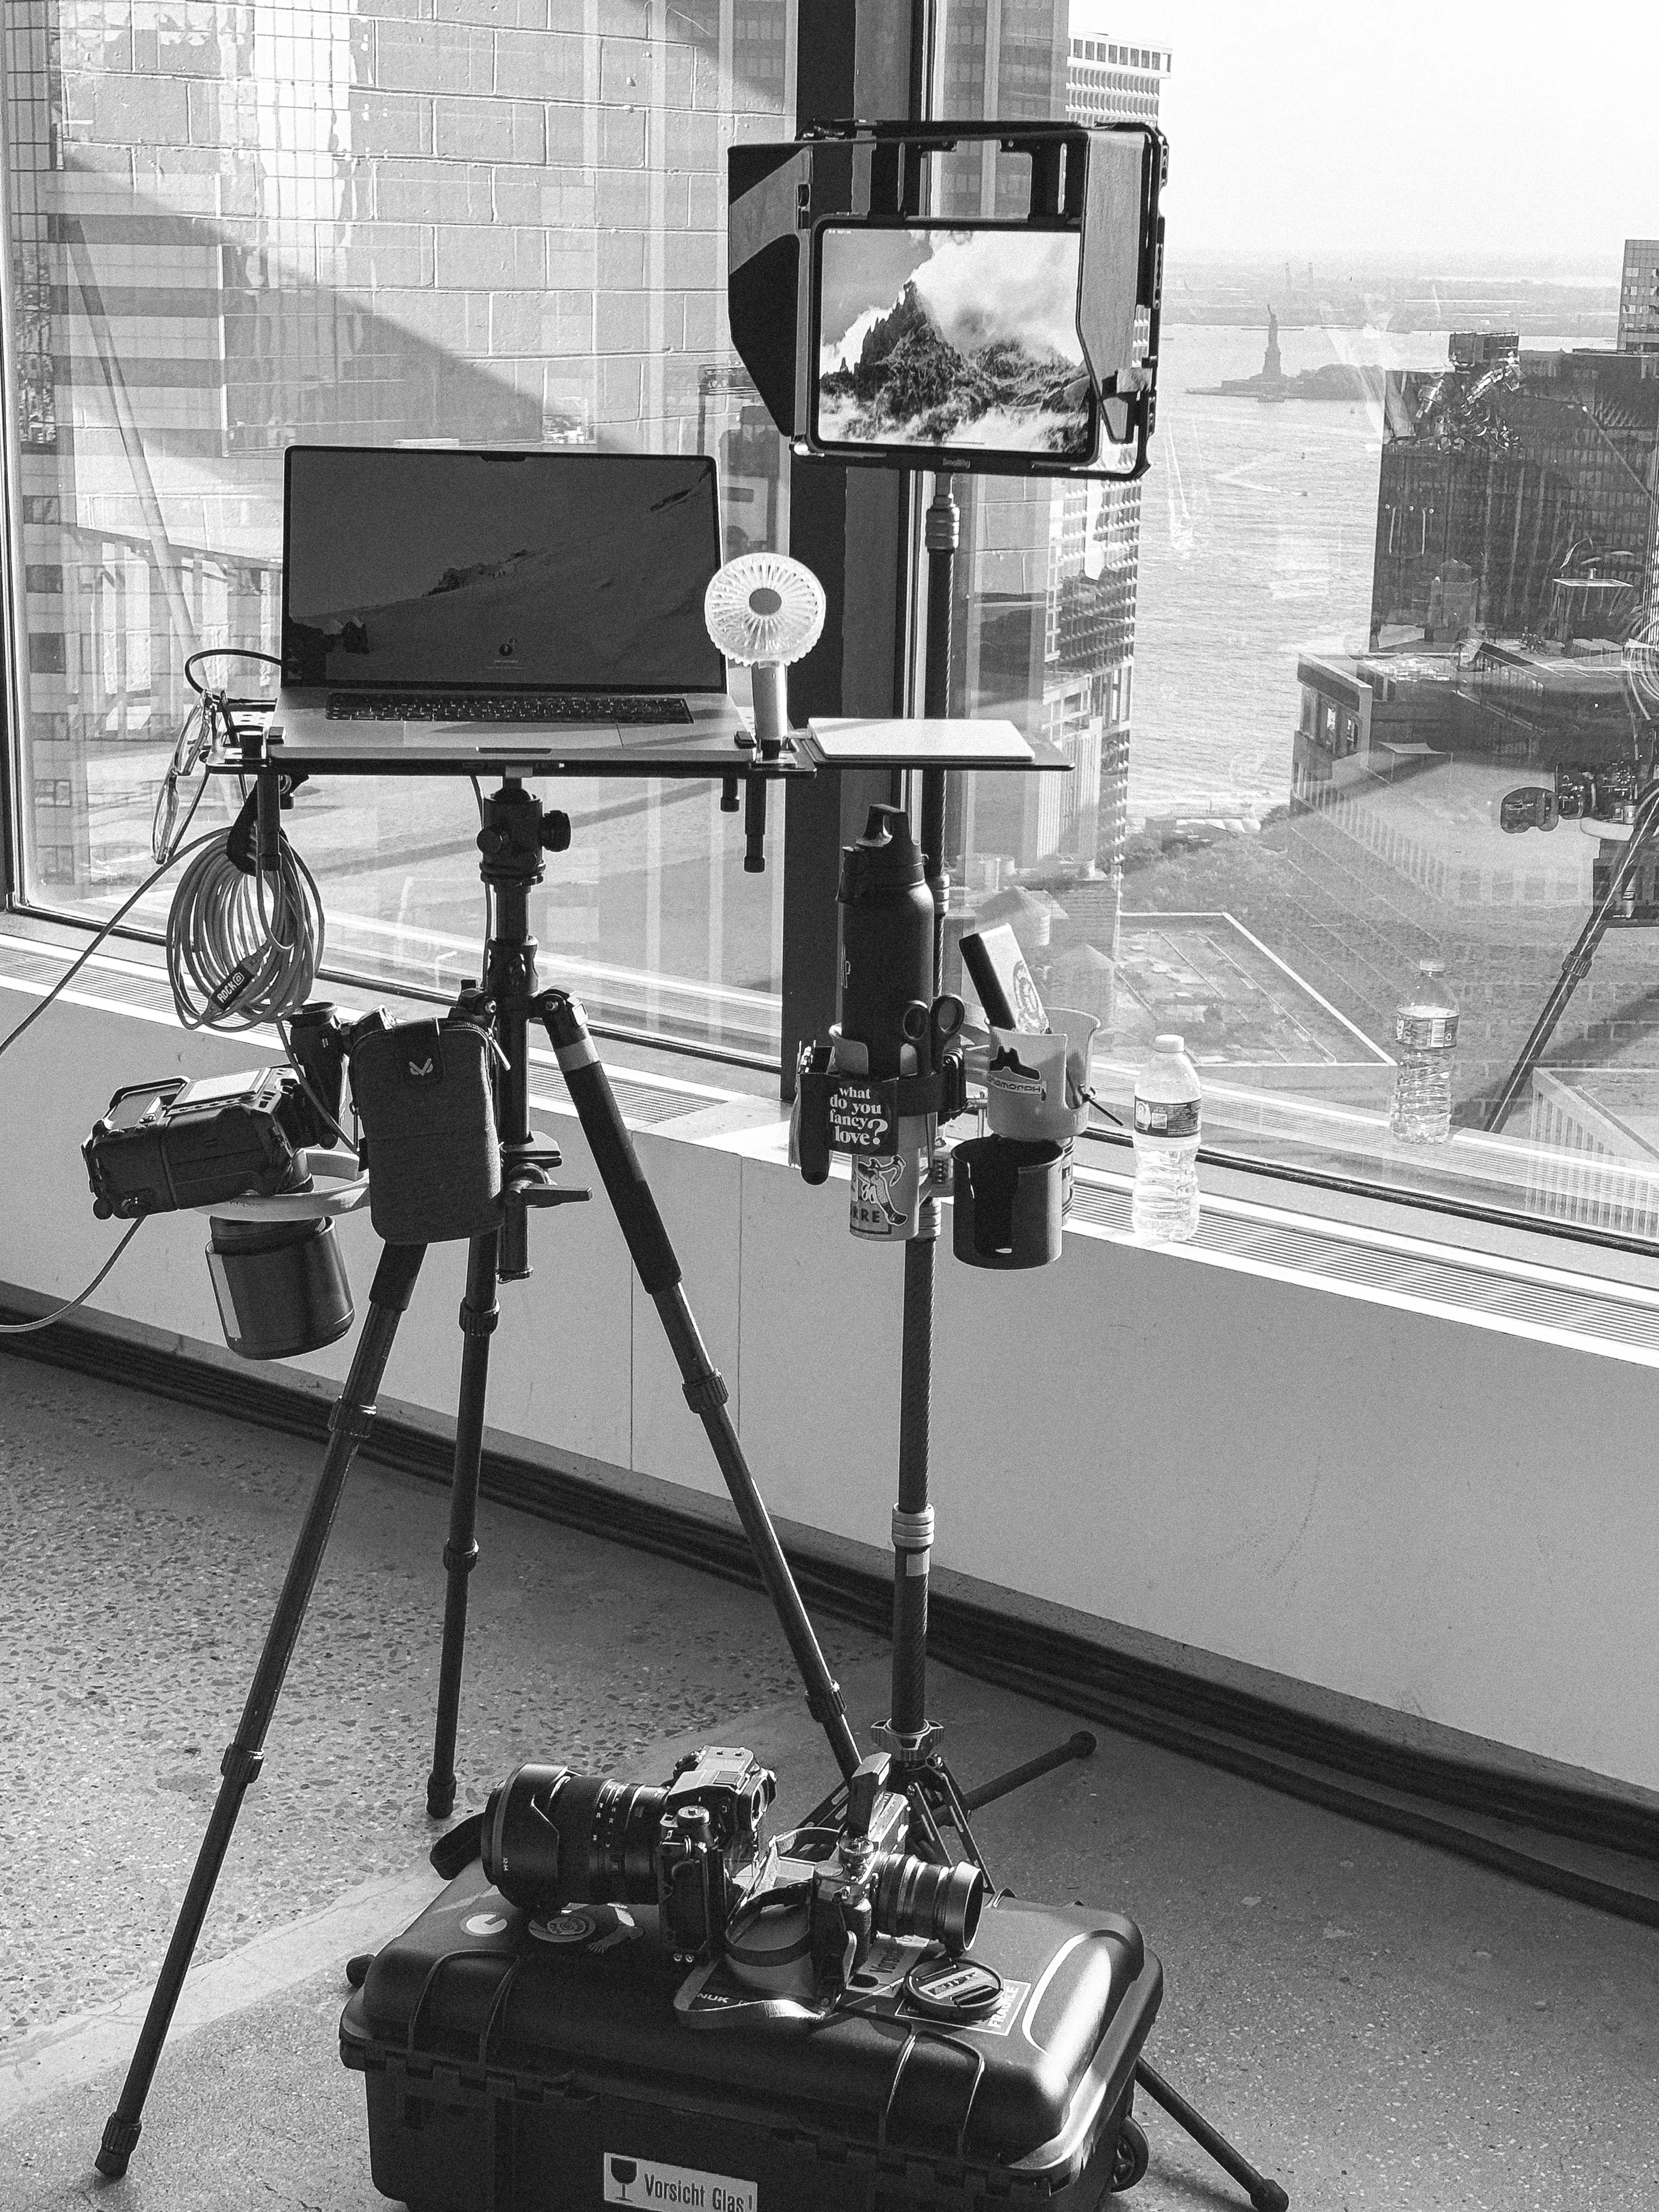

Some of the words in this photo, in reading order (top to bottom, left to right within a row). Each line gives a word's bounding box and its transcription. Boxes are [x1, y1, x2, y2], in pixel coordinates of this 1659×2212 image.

[217, 981, 237, 1004] ROCK
[839, 1086, 871, 1100] what
[830, 1094, 848, 1110] do
[851, 1100, 882, 1115] you
[829, 1109, 869, 1130] fancy
[644, 2173, 706, 2207] Vorsicht
[712, 2187, 744, 2212] Glas
